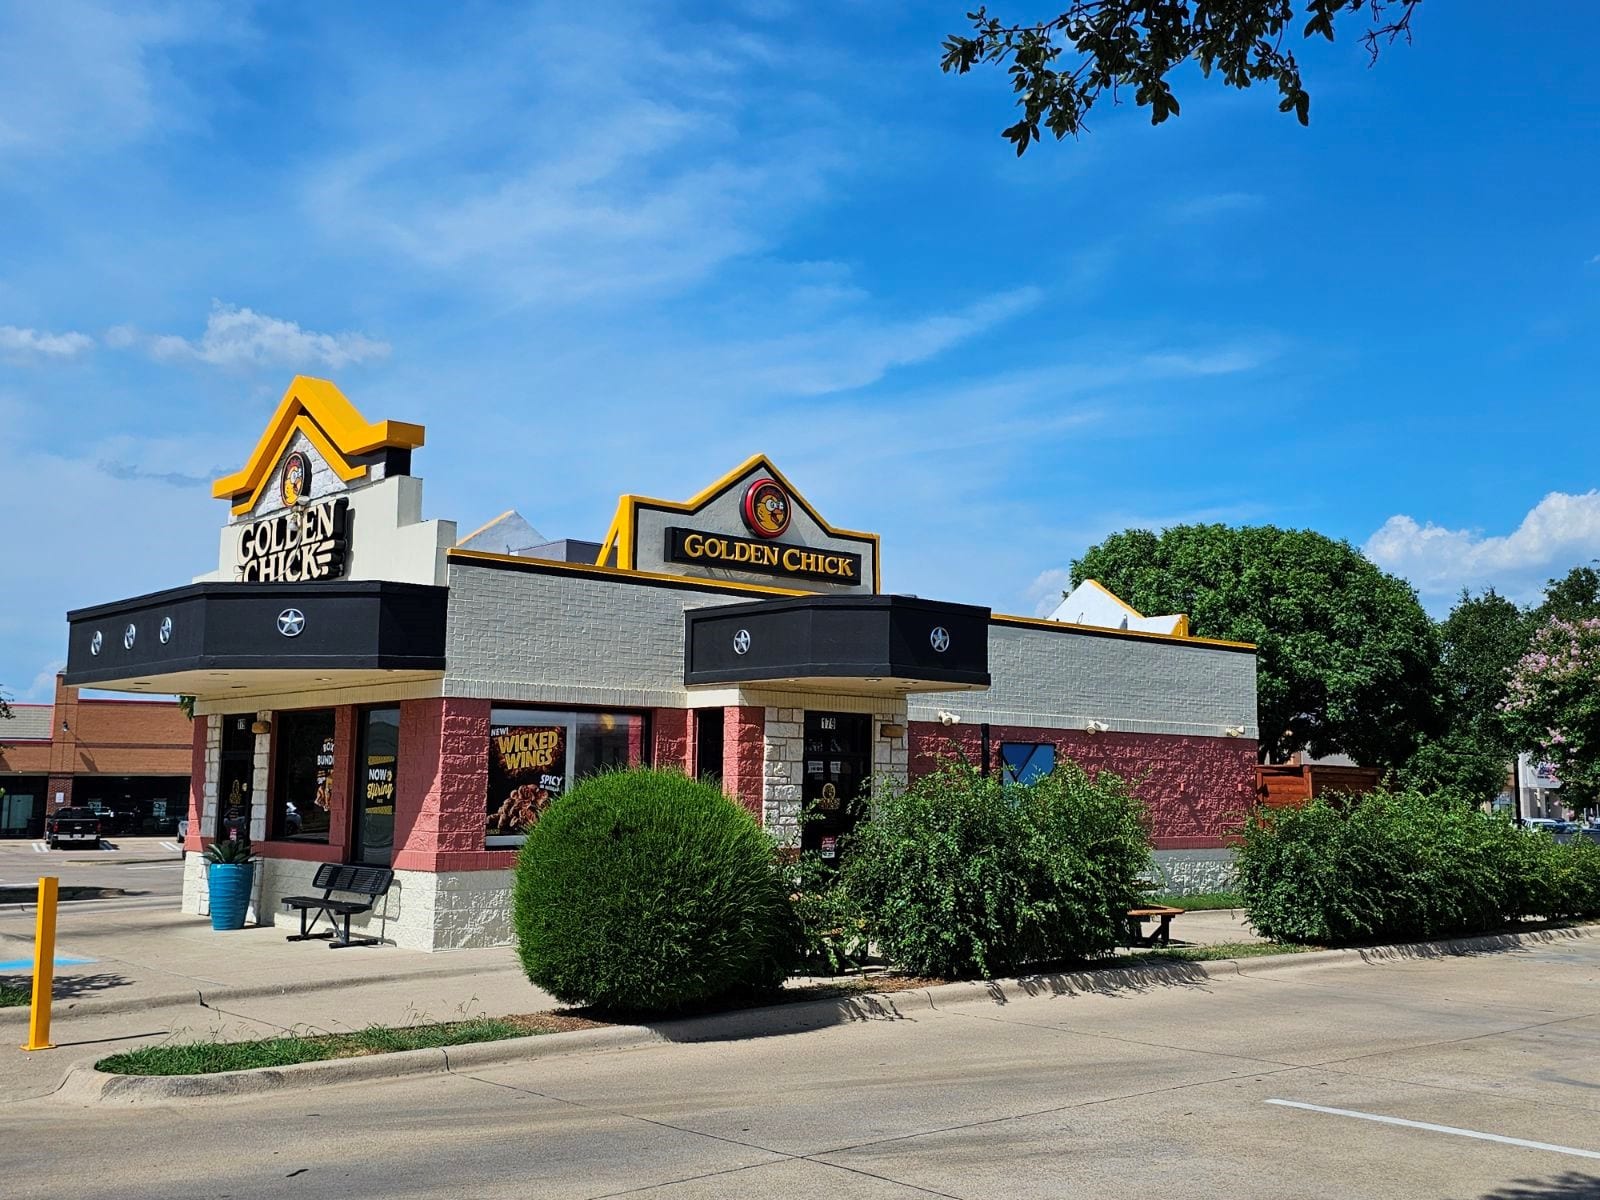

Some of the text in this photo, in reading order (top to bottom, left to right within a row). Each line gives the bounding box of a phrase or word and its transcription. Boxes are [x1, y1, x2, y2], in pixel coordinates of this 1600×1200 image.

[238, 500, 336, 564] GOLDEN
[243, 541, 321, 582] CHICK
[684, 534, 854, 577] GOLDEN CHICK
[490, 727, 509, 737] NEW!
[498, 731, 558, 754] WICKED
[317, 755, 334, 766] BUND
[505, 749, 553, 769] WINGS
[369, 769, 387, 780] NOW
[540, 774, 563, 786] SPICY
[367, 781, 393, 800] Hiring
